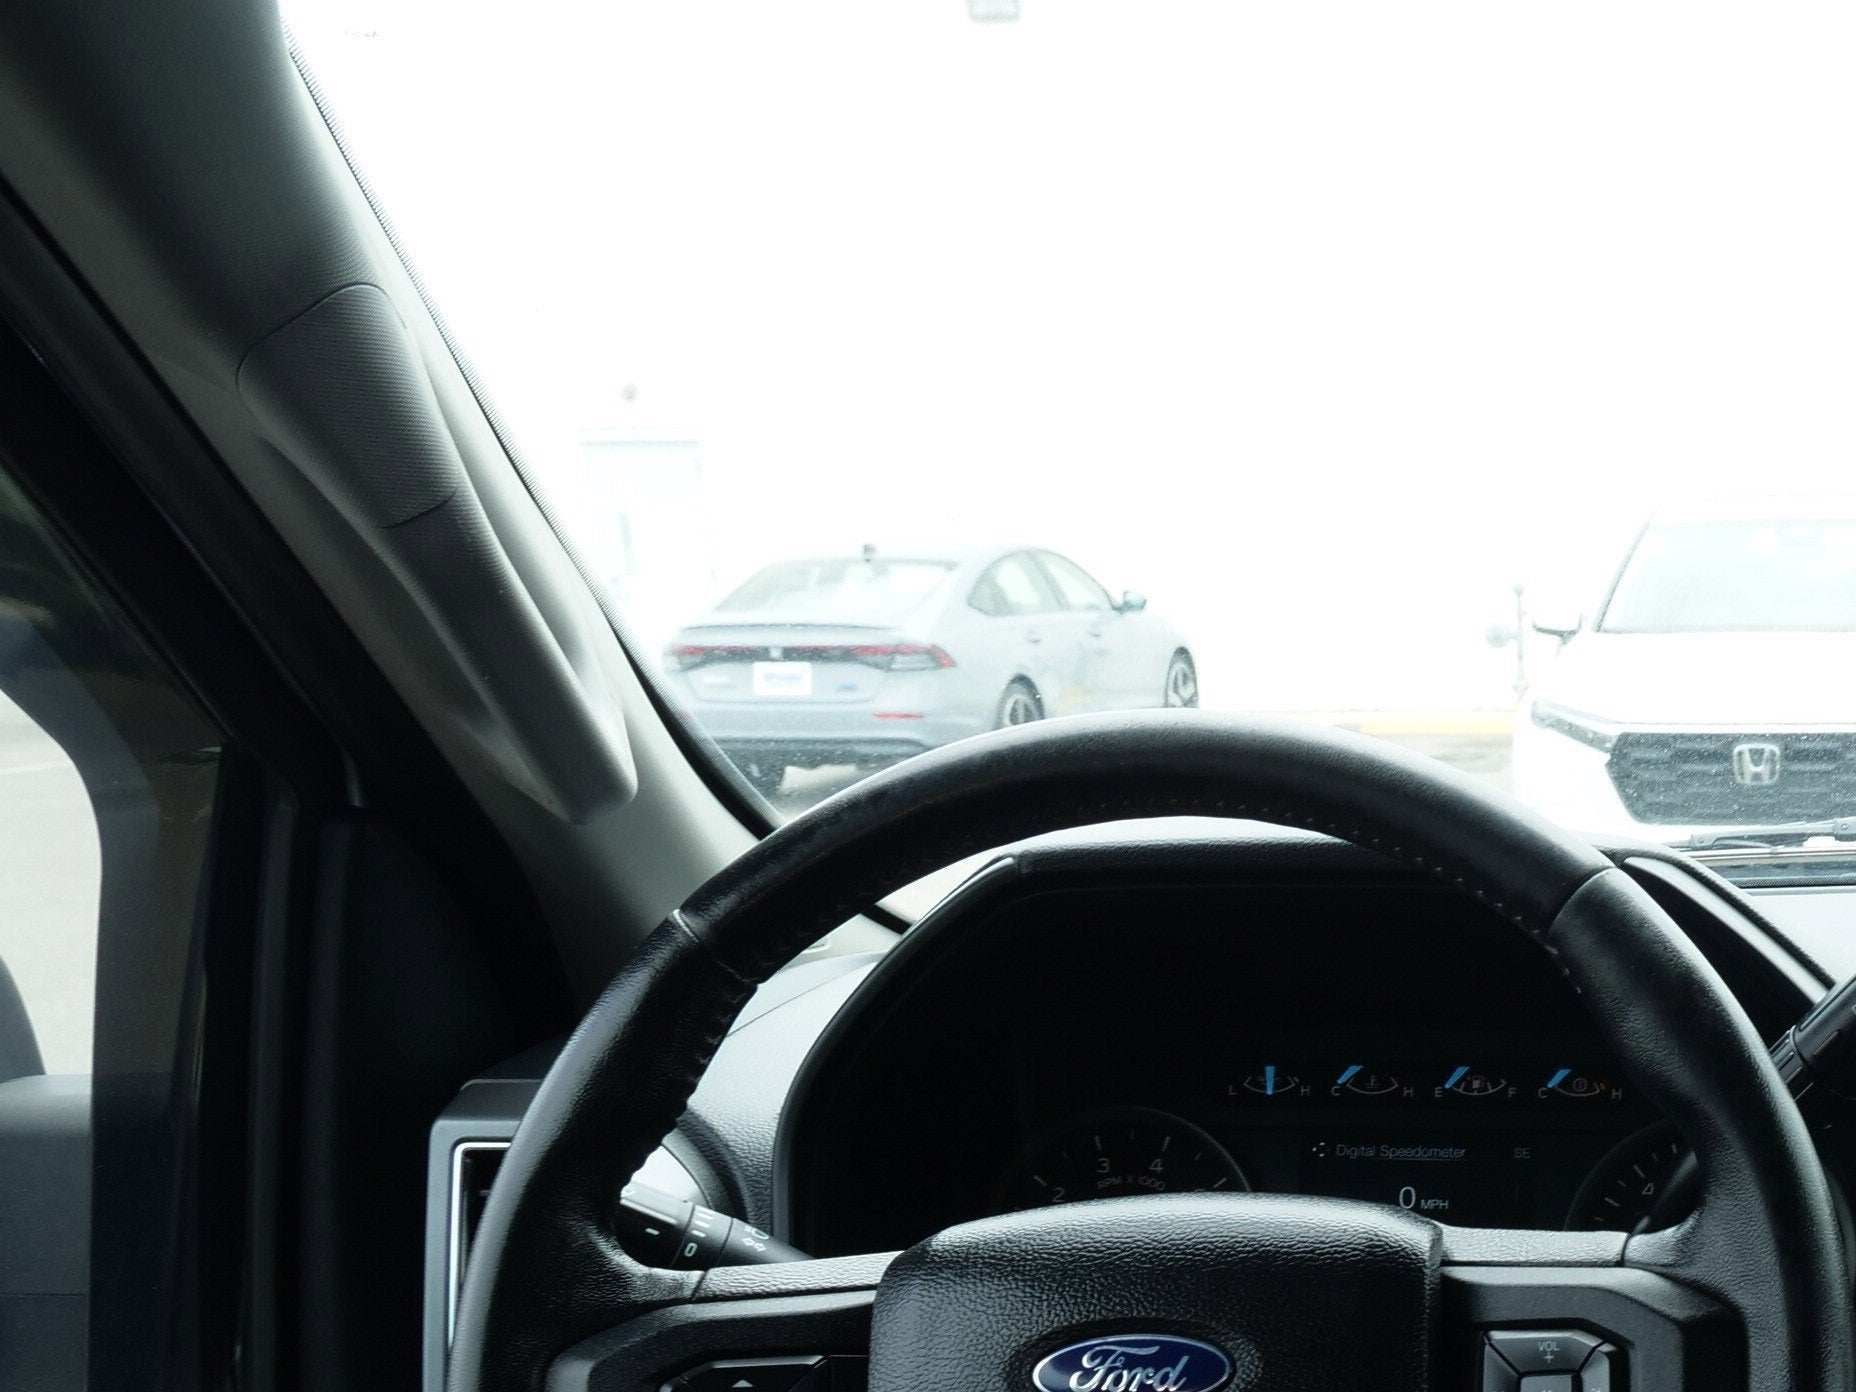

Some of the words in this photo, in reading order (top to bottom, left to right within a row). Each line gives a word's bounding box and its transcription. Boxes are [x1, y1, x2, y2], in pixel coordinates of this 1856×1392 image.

[1228, 1083, 1238, 1096] L
[1300, 1085, 1312, 1097] H
[1330, 1085, 1342, 1097] C
[1402, 1086, 1415, 1098] H
[1433, 1086, 1444, 1098] E
[1507, 1086, 1518, 1099] F
[1537, 1086, 1549, 1099] C
[1611, 1087, 1623, 1100] H
[1336, 1143, 1376, 1159] Digital
[1380, 1144, 1467, 1160] Speedometer
[1513, 1147, 1532, 1159] SE
[1097, 1157, 1111, 1174] 3
[1149, 1157, 1164, 1174] 4
[1052, 1186, 1066, 1202] 2
[1398, 1185, 1417, 1210] 0
[1420, 1199, 1450, 1211] MPH
[1537, 1340, 1561, 1352] VOL
